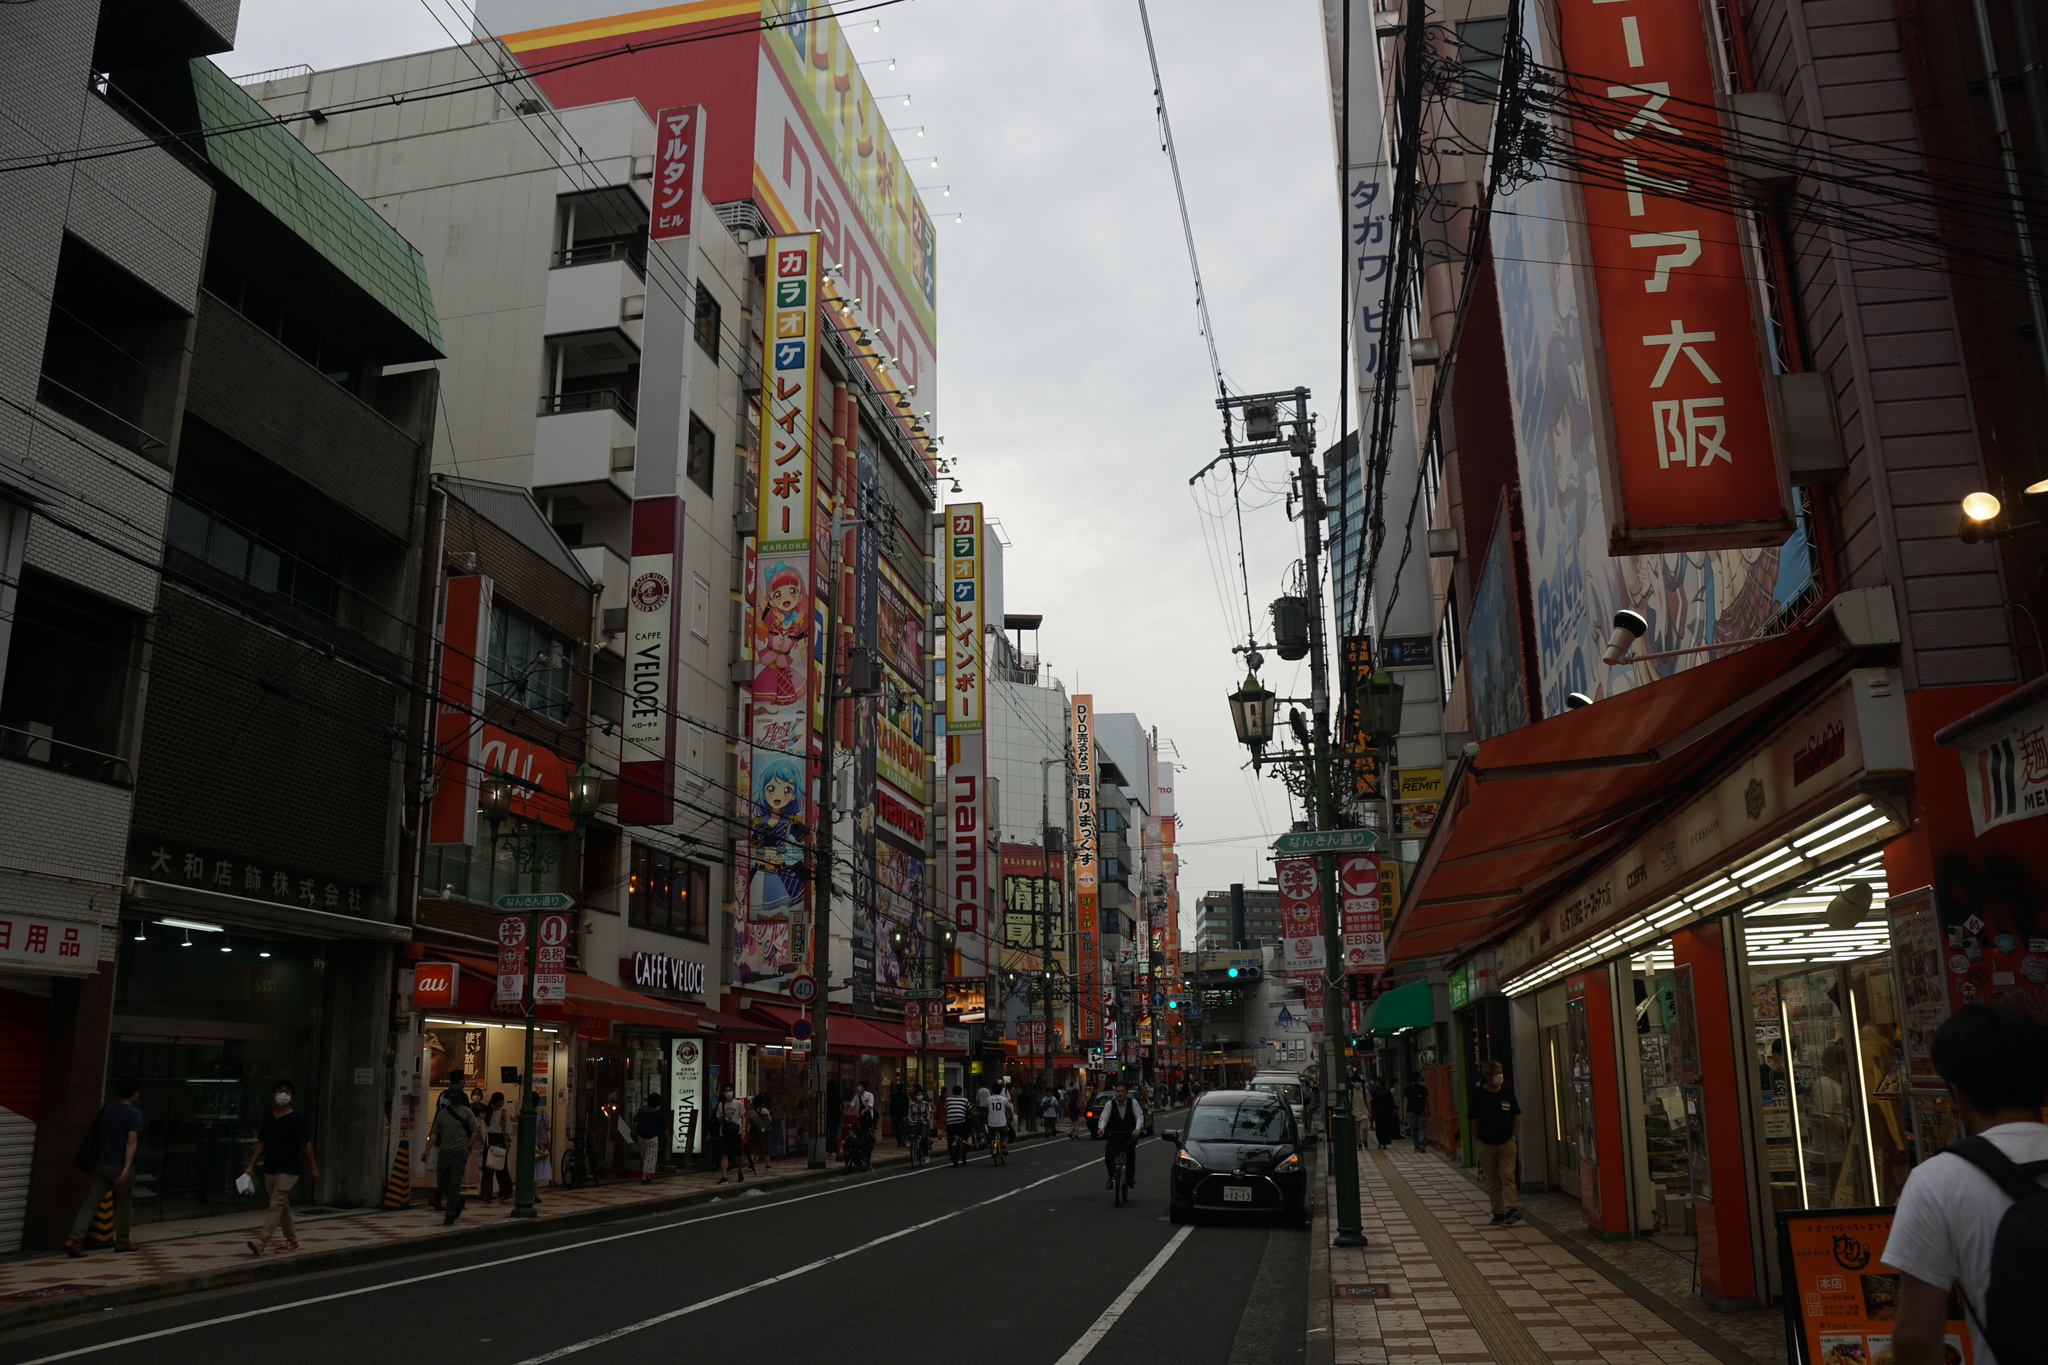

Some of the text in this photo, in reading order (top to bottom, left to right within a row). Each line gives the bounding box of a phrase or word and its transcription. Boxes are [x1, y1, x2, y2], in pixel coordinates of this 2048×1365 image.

[661, 115, 690, 208] マルタン
[658, 215, 684, 229] ビル
[1592, 0, 1734, 470] ーストア大阪
[782, 116, 919, 396] namco
[762, 541, 809, 552] KARAOKE
[632, 644, 661, 718] VELOCE
[950, 722, 982, 730] KARAOKE
[886, 765, 912, 796] KARAOKE
[1393, 780, 1398, 790] 3
[1402, 781, 1441, 791] REMIT
[876, 788, 925, 842] namco
[1395, 813, 1401, 825] 2
[1289, 833, 1365, 847] なんさん通り
[955, 776, 978, 933] namco
[151, 846, 362, 912] 大和店飾株式会社
[1283, 864, 1314, 898] 薬
[506, 897, 559, 906] なんさん通り
[1346, 901, 1379, 911] ようこそ
[501, 918, 522, 944] 薬
[1289, 923, 1316, 934] えびす
[1346, 933, 1382, 945] EBISU
[540, 949, 564, 960] 免税
[634, 951, 706, 994] CAFFÈ VELOCE
[418, 977, 449, 993] au
[537, 976, 564, 984] EBISU
[796, 983, 812, 996] 40
[992, 1102, 1001, 1111] 10
[1820, 1278, 1843, 1289] 本店
[1827, 1322, 1847, 1330] Food
